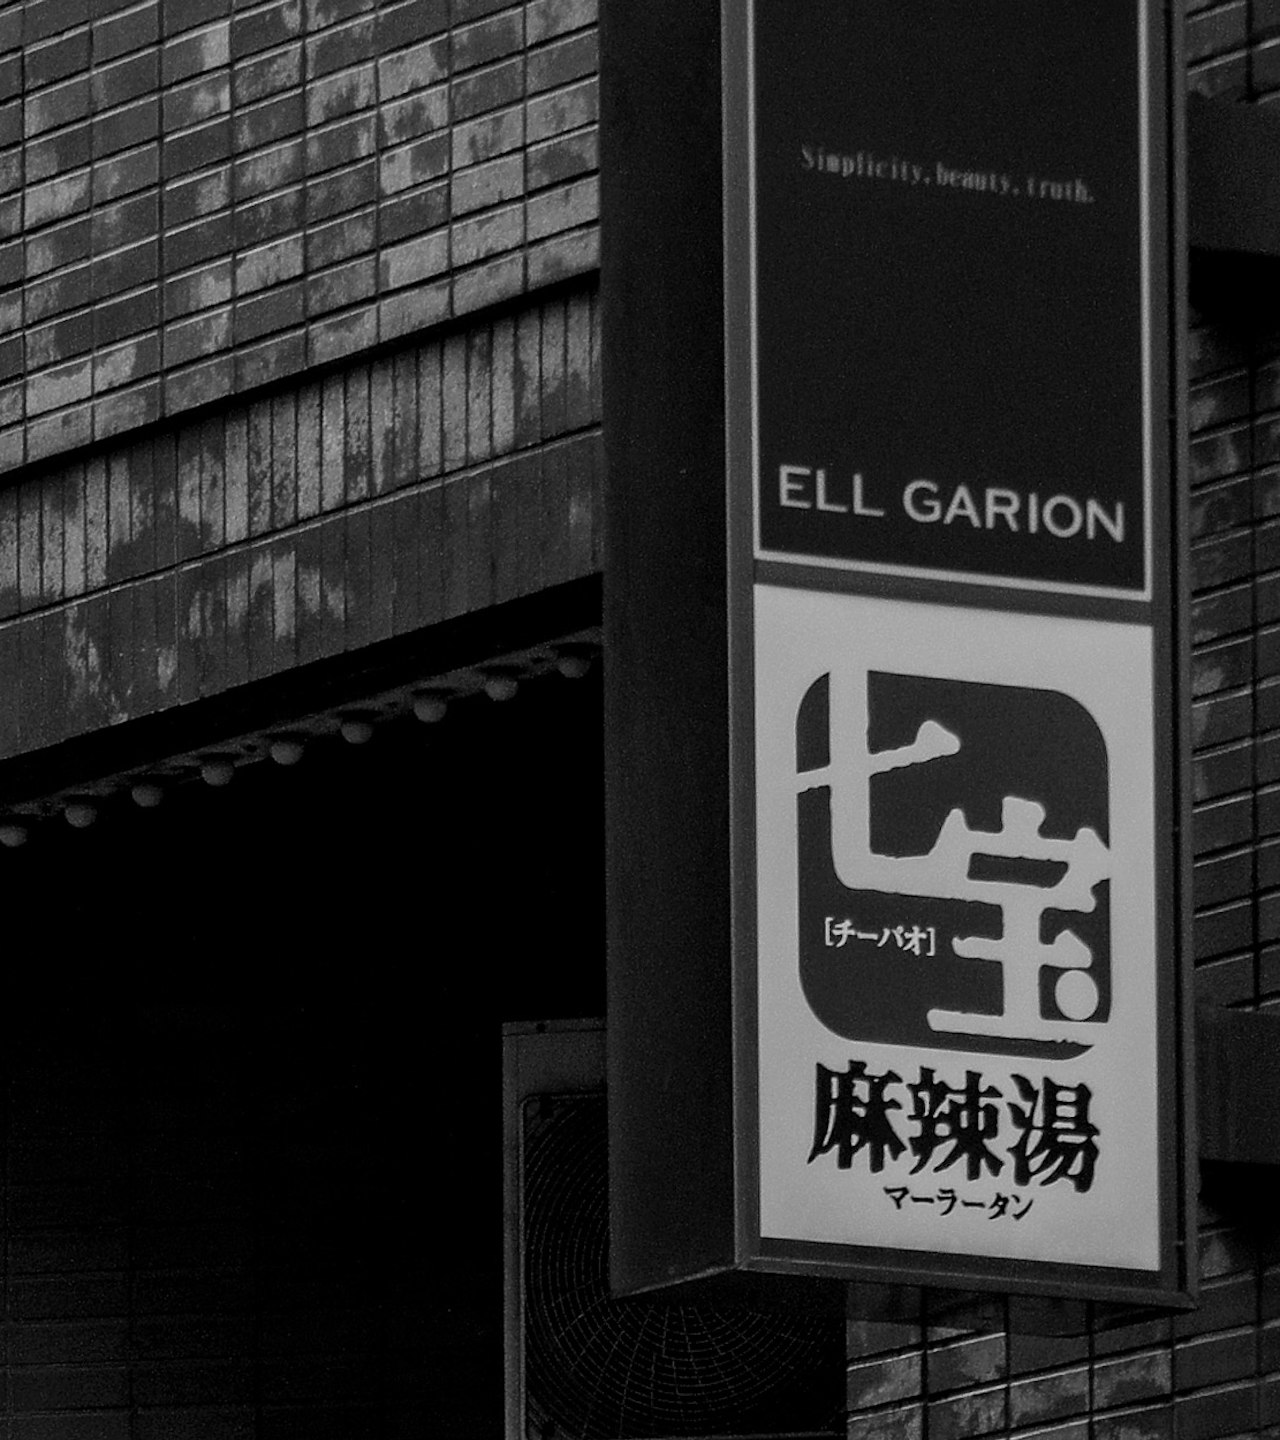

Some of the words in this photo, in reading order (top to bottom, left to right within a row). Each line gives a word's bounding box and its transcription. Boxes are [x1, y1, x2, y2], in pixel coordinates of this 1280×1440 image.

[778, 464, 885, 518] ELL
[902, 479, 1125, 543] GARION
[806, 1059, 1101, 1195] 麻辣湯
[883, 1185, 1034, 1222] マーラータン
